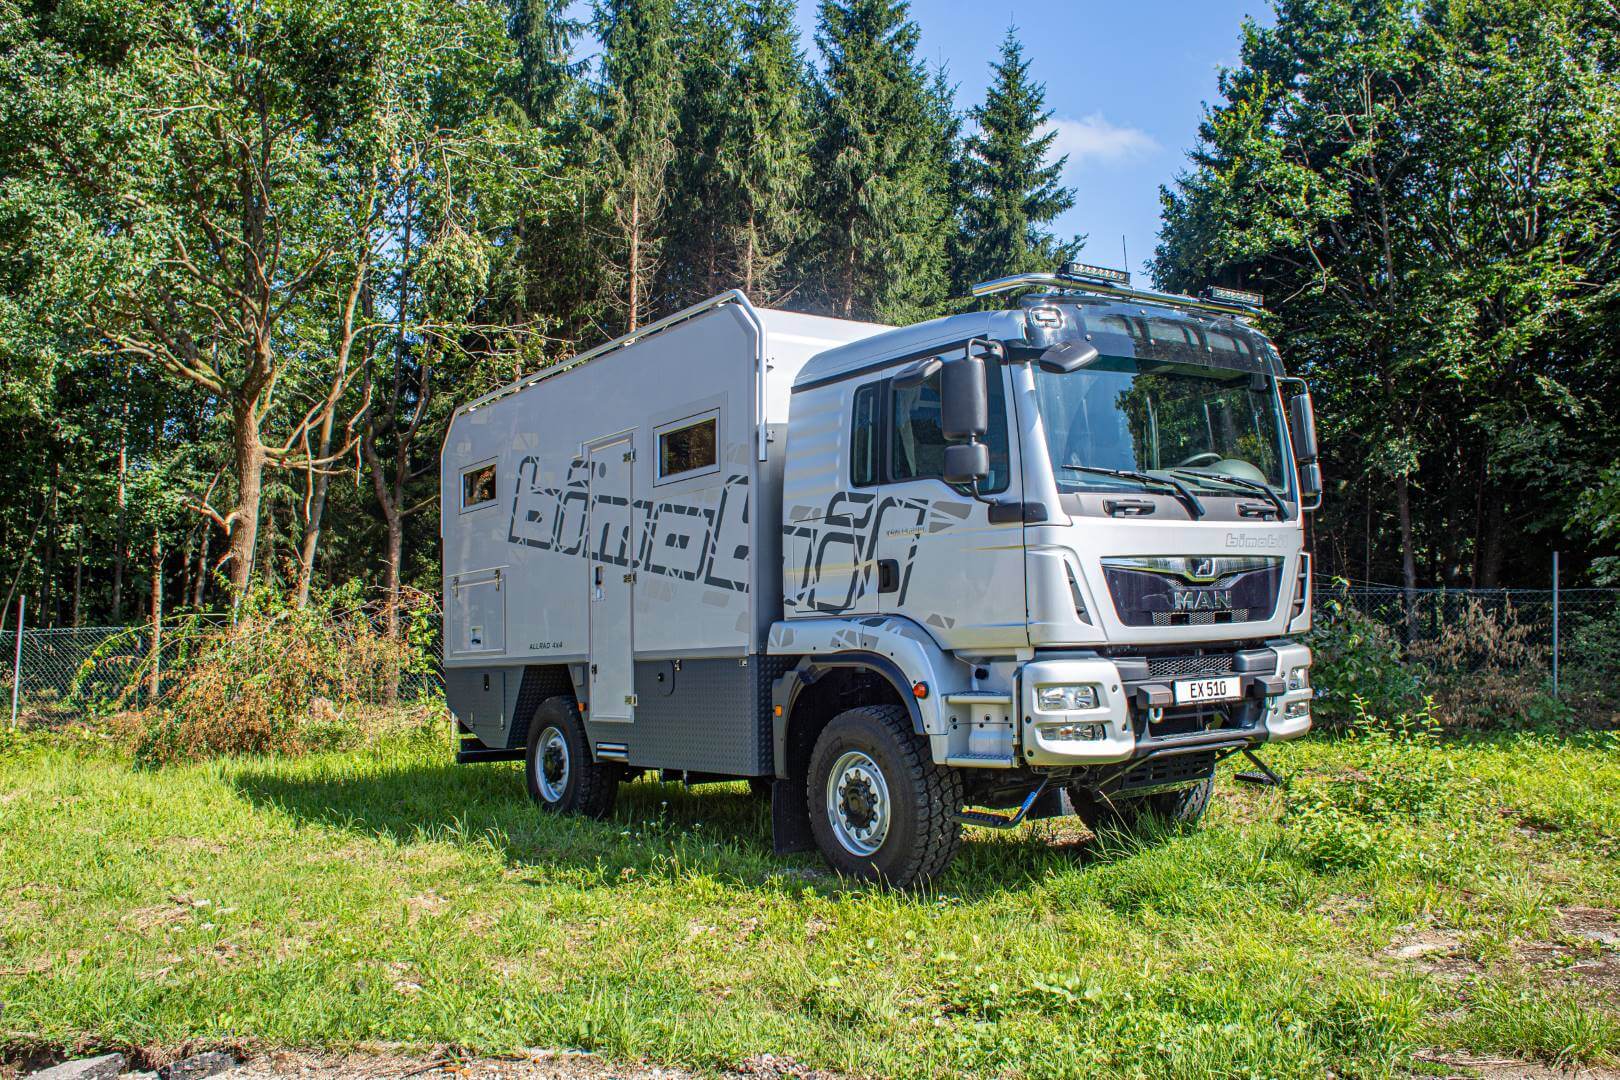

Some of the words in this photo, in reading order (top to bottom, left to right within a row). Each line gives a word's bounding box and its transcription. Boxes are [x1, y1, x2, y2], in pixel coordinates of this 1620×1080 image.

[1174, 590, 1232, 610] MAN
[1190, 682, 1204, 698] EX
[1206, 680, 1227, 697] 510
